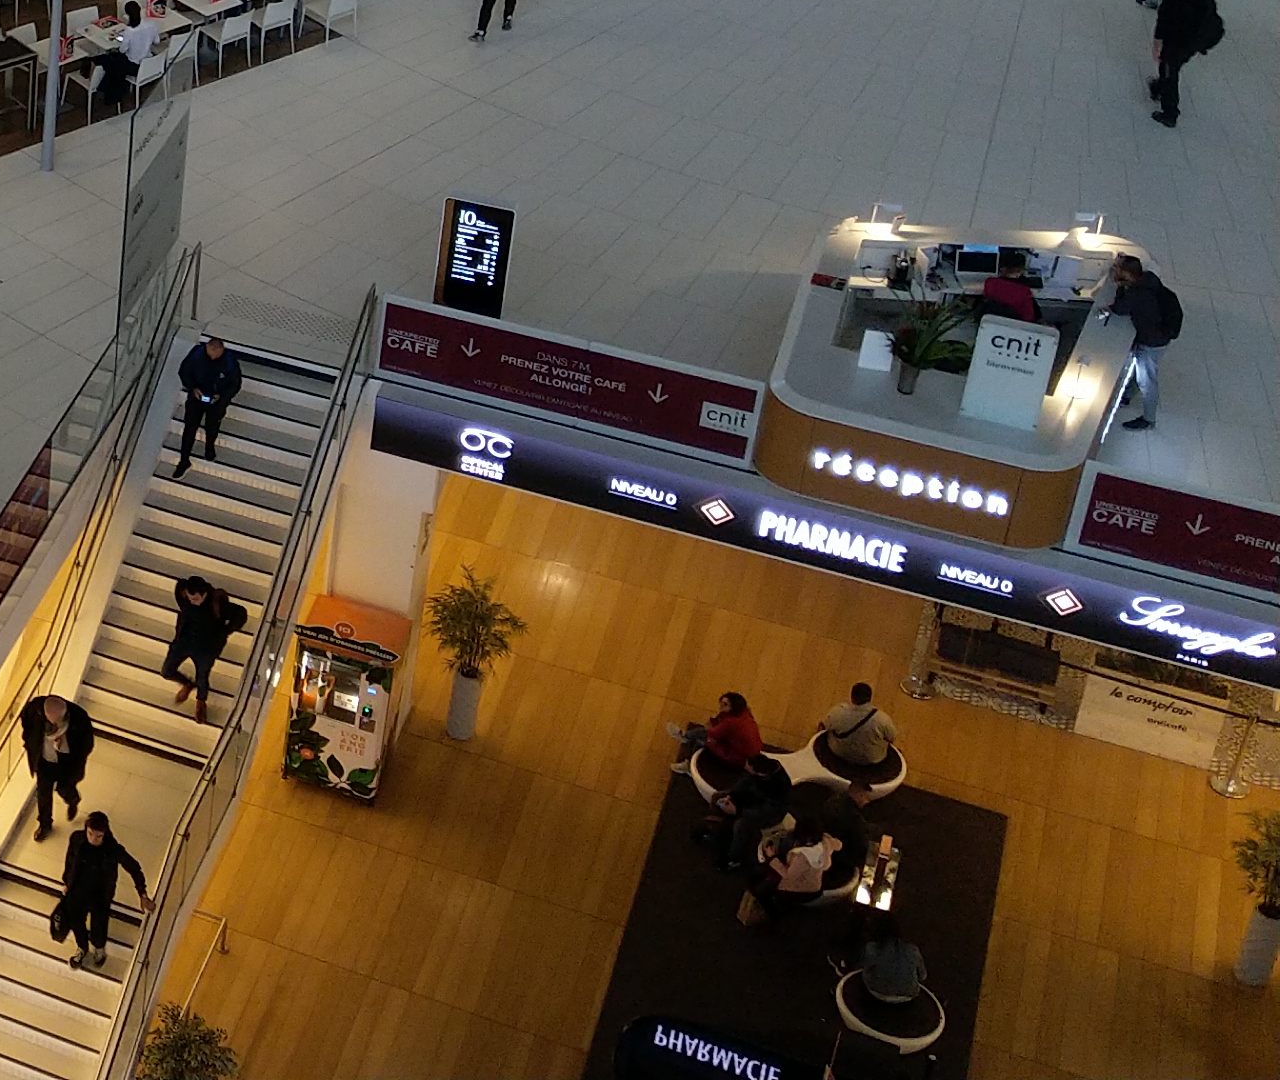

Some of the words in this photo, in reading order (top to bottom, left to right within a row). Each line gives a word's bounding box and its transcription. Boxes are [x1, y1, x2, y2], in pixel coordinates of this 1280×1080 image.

[387, 327, 441, 345] UNEXPECTED
[991, 335, 1042, 357] cnit
[536, 351, 568, 367] DANS
[500, 354, 550, 373] PRENEZ
[551, 366, 591, 384] VOTRE
[593, 376, 628, 393] CAFÉ
[706, 406, 748, 429] cnit
[460, 463, 504, 481] CENTER
[610, 478, 664, 503] NIVEAU
[814, 451, 1010, 517] réception
[1095, 499, 1159, 520] UNEXPECTED
[758, 510, 909, 574] PHARMACIE
[939, 563, 998, 590] NIVEAU
[1175, 652, 1209, 667] PARIS
[1109, 686, 1123, 698] le
[1126, 694, 1194, 716] comptoir
